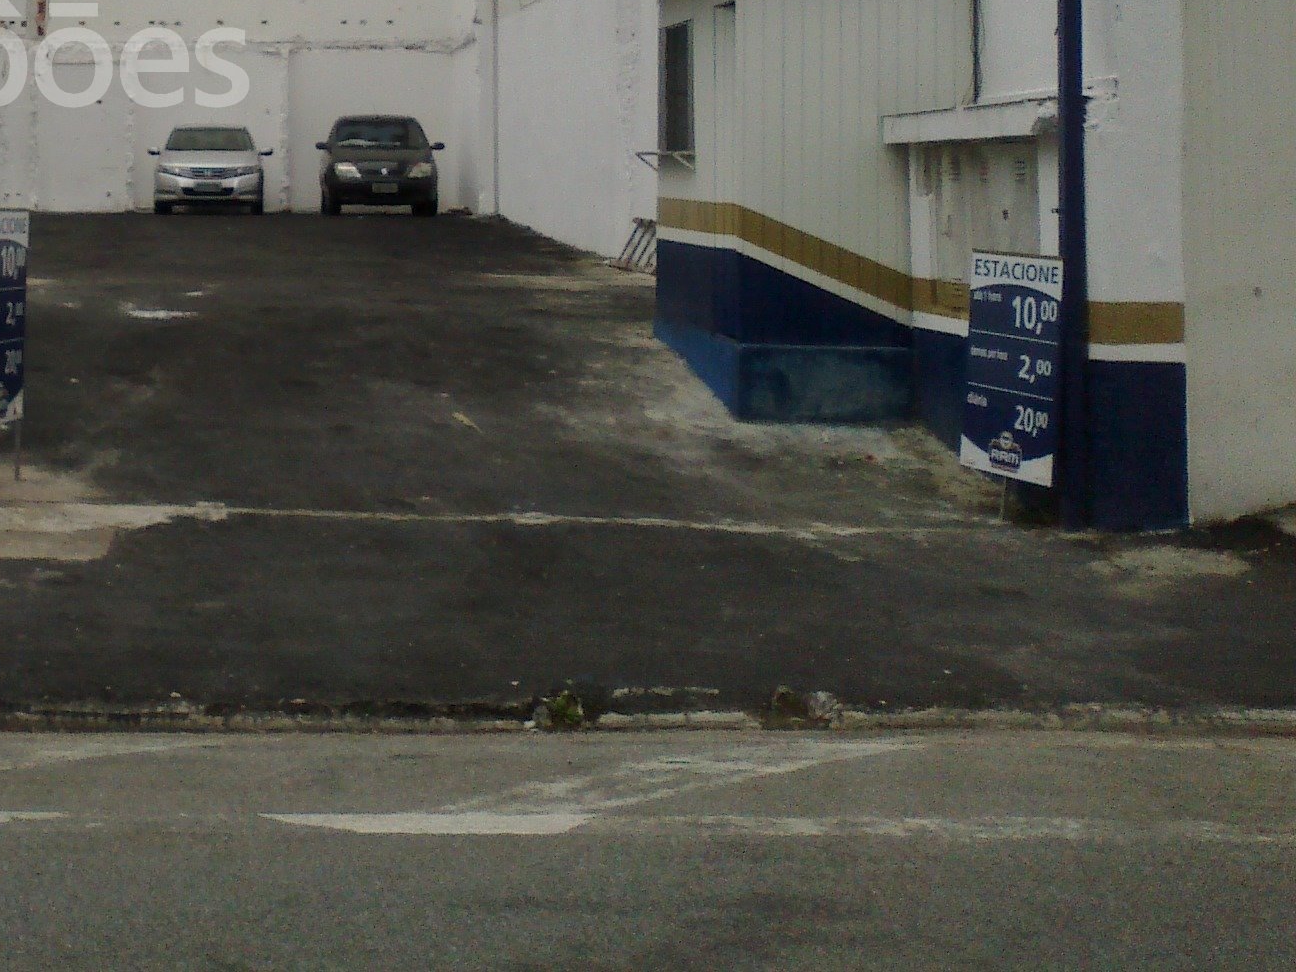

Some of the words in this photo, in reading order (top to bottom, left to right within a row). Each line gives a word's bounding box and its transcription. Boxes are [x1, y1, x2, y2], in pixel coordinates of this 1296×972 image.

[974, 258, 1059, 284] ESTACIONE
[1011, 295, 1058, 335] 10,00
[1018, 354, 1052, 384] 2,00
[1013, 404, 1049, 438] 20,00
